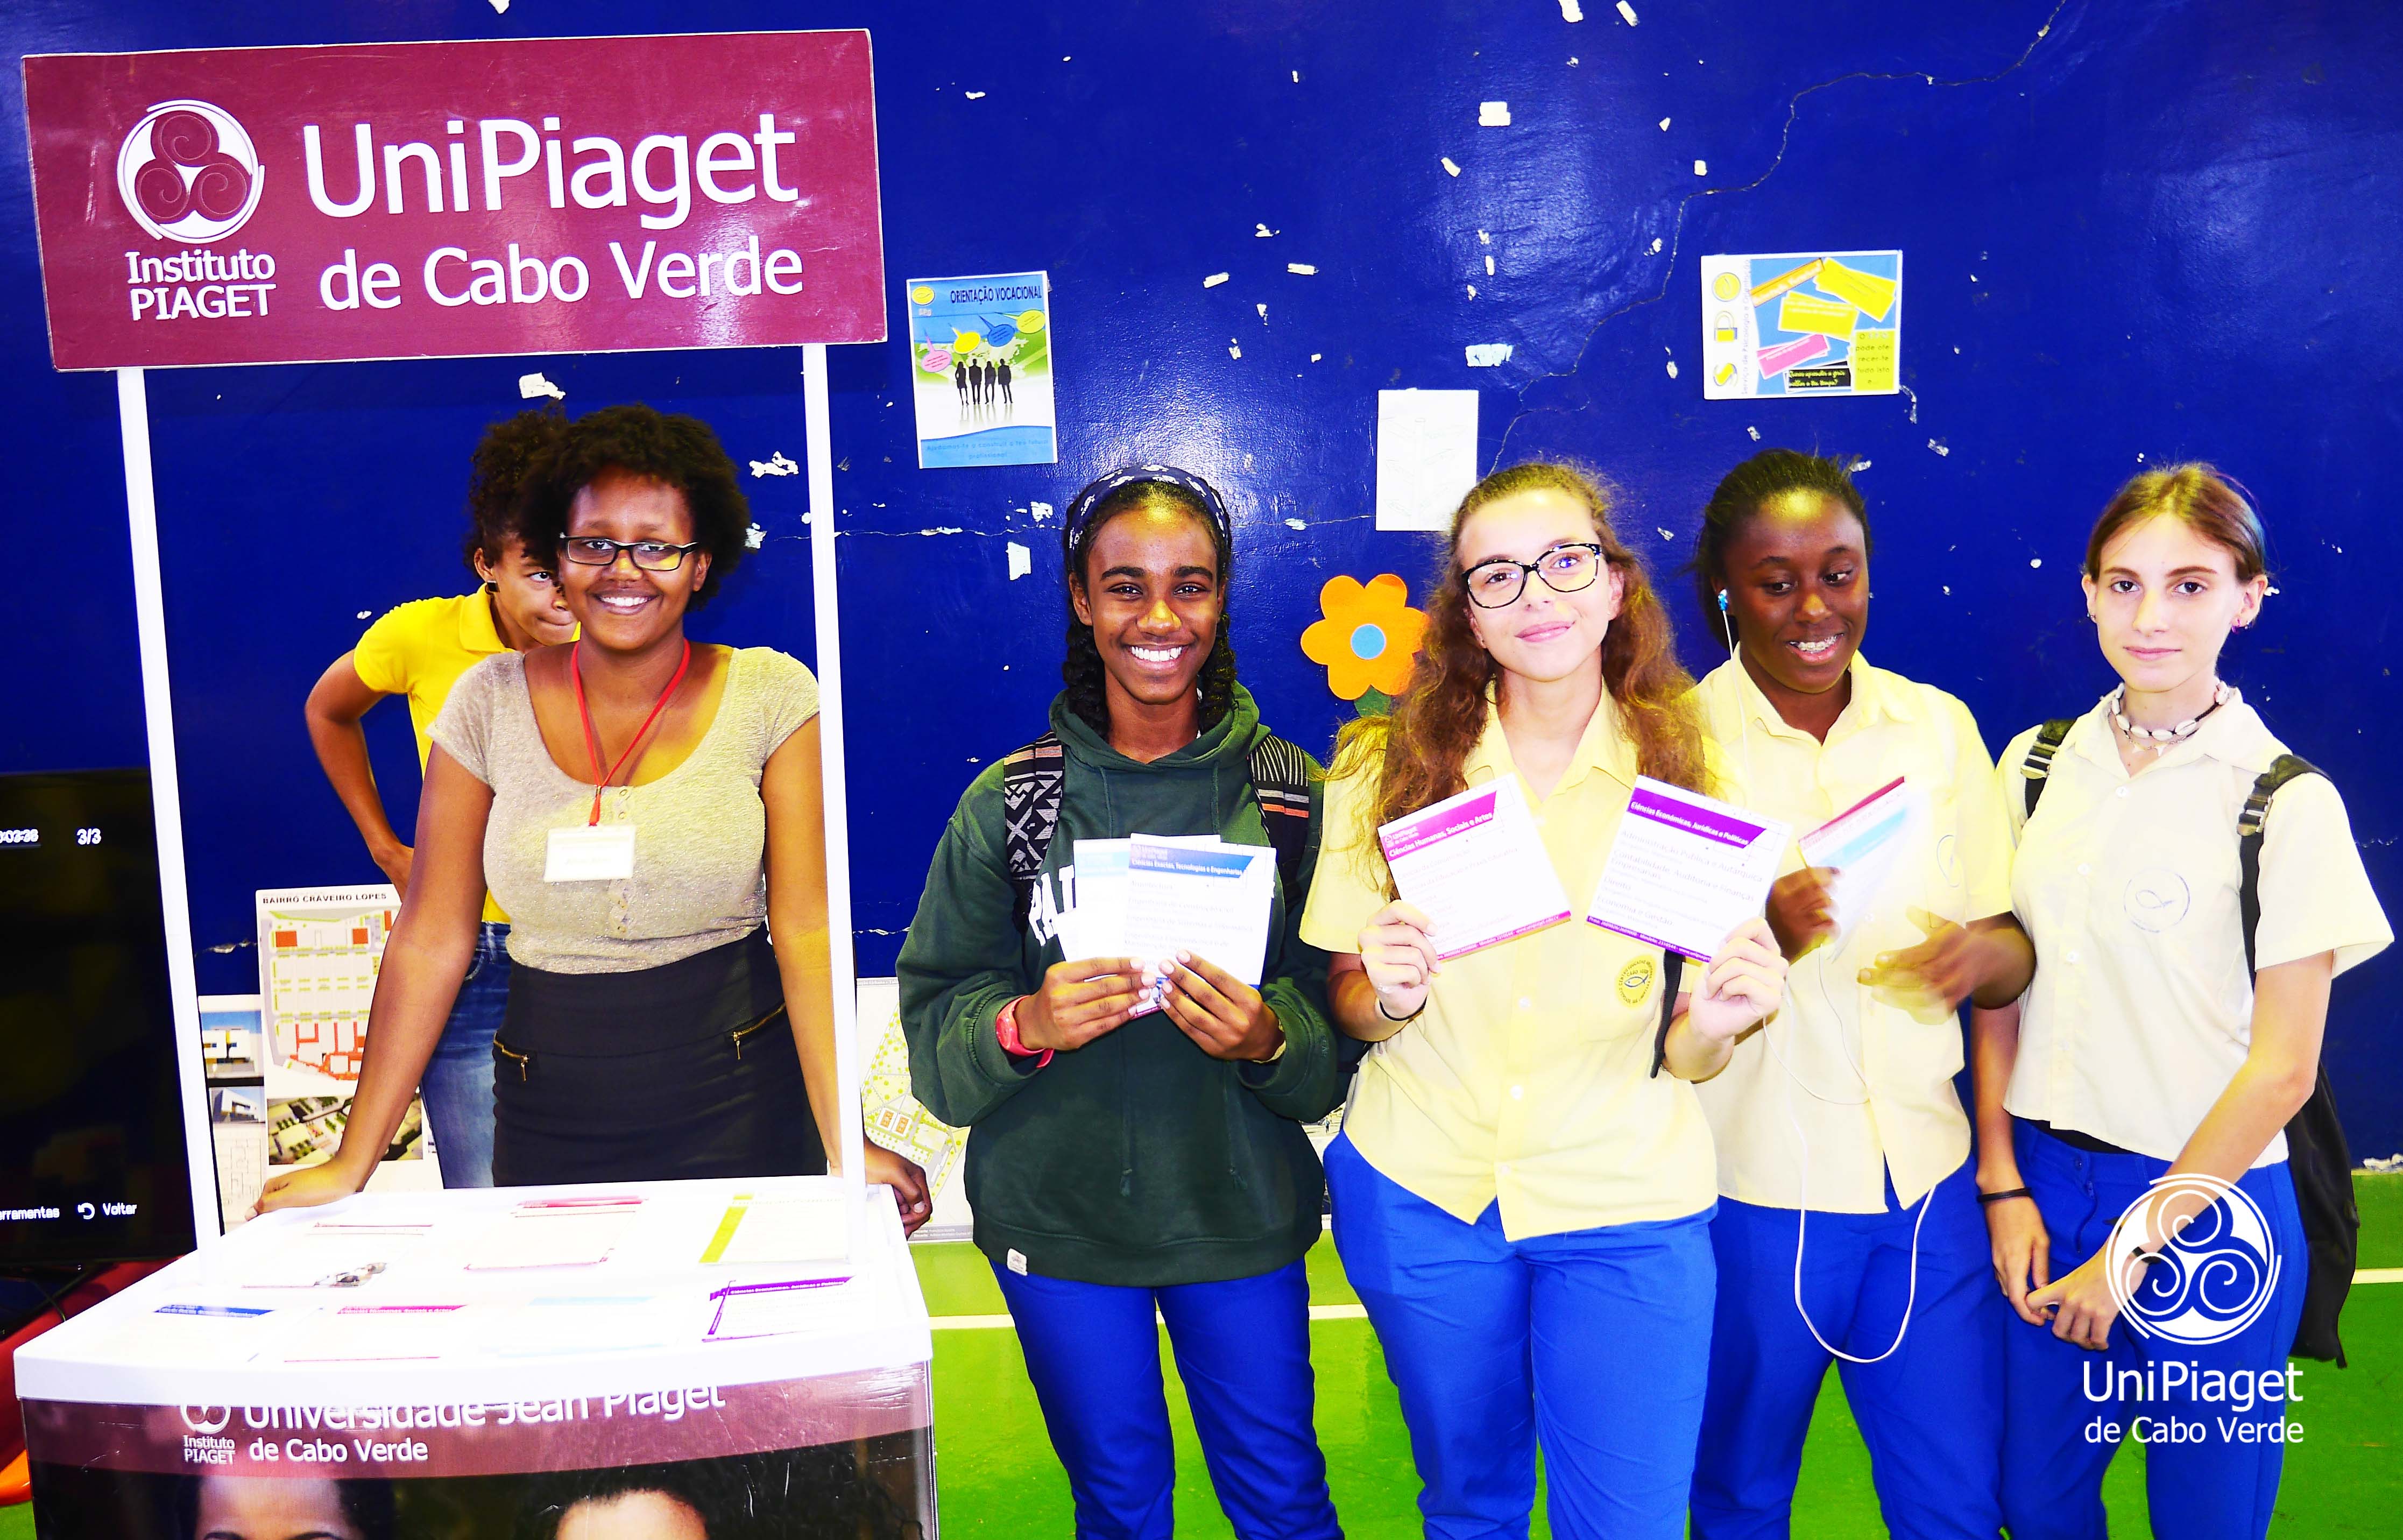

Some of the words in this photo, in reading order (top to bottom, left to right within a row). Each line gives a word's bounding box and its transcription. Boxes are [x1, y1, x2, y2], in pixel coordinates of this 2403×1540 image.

[303, 114, 799, 229] UniPiaget
[125, 249, 275, 284] Instituto
[320, 249, 401, 310] de
[424, 244, 589, 307] Cabo
[609, 236, 803, 299] Verde
[130, 284, 276, 321] PIAGET
[951, 286, 994, 305] ORIENTAÇÃO
[995, 286, 1042, 300] VOCACIONAL
[77, 828, 101, 845] 3/3
[1389, 842, 1415, 857] Ciências
[1415, 831, 1447, 847] Humanas,
[1446, 821, 1468, 835] Sociais
[1474, 812, 1493, 824] Artes
[1631, 801, 1656, 816] Ciências
[1655, 809, 1692, 828] Económicas,
[1692, 822, 1719, 837] Jurídicas
[1723, 832, 1749, 845] Políticas
[263, 896, 299, 904] BAIRRO
[303, 894, 352, 902] CRAVEIRO
[102, 1202, 137, 1216] Voltar
[244, 1403, 486, 1430] Universidade
[498, 1397, 589, 1425] Jean
[604, 1386, 726, 1422] Piaget
[183, 1435, 235, 1450] Instituto
[184, 1449, 235, 1464] PIAGET
[249, 1437, 279, 1461] de
[286, 1438, 348, 1462] Cabo
[353, 1437, 428, 1462] Verde
